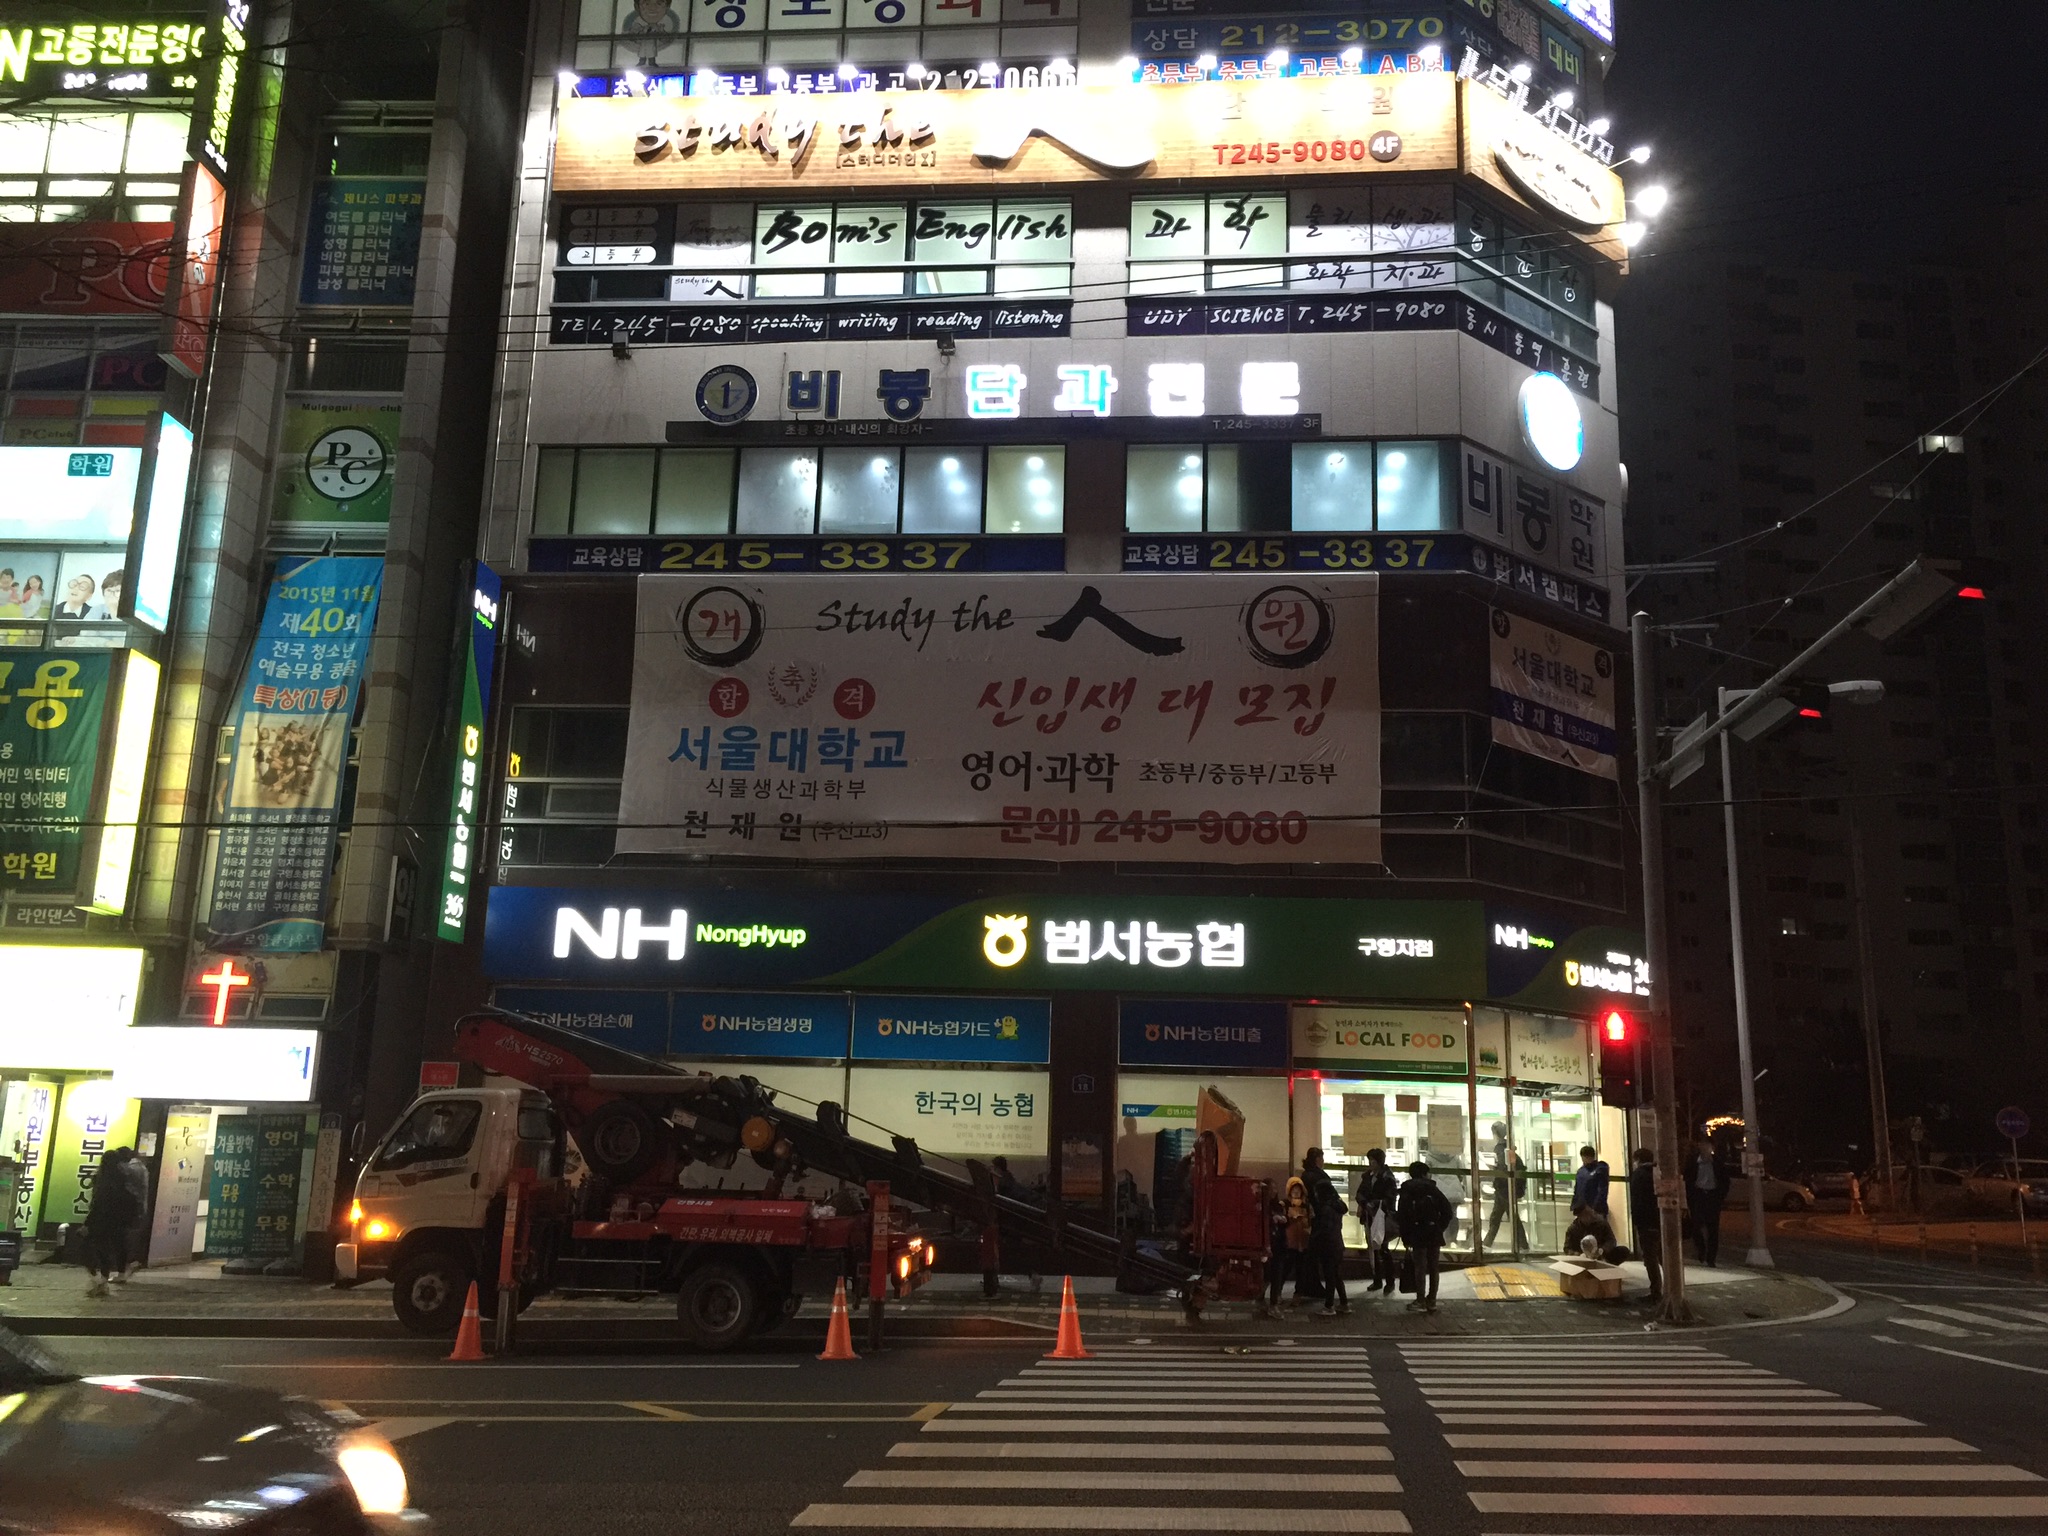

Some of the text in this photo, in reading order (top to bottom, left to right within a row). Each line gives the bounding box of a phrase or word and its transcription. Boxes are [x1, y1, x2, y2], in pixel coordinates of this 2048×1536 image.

[1144, 17, 1444, 51] 상담 212-3070
[1548, 38, 1579, 85] 대비
[1213, 136, 1399, 165] T245-9080 4F
[385, 193, 422, 205] 피부과
[763, 210, 898, 255] Bom's
[914, 209, 1068, 251] English
[320, 251, 347, 263] 비만
[838, 312, 897, 333] writing
[916, 311, 982, 331] reading
[995, 309, 1065, 331] listening
[1210, 306, 1285, 325] SCIENCE
[787, 369, 932, 421] 비봉
[1303, 417, 1319, 428] 3F
[71, 454, 111, 476] 학원
[1467, 452, 1598, 576] 비봉 학원
[572, 547, 644, 568] 교육상담
[1124, 540, 1436, 569] 교육상담 245-3337
[278, 585, 375, 603] 2015년 11월
[1493, 552, 1603, 618] 범서캠퍼스
[279, 607, 362, 638] 제40회
[697, 607, 742, 642] 개
[815, 596, 937, 653] Study
[953, 593, 1016, 633] the
[1258, 598, 1308, 651] 원
[272, 640, 356, 661] 전국 청소년
[258, 658, 324, 681] 예술무용
[1511, 645, 1598, 698] 서울대학교
[253, 684, 349, 711] 특상(1등)
[717, 665, 866, 712] 합 축 격
[976, 676, 1338, 744] 신입생 대 모집
[667, 725, 909, 773] 서울대학교
[24, 766, 71, 784] 엑티비티
[961, 750, 1338, 794] 영어·과학 초등부/중등부/고등부
[20, 791, 68, 809] 영어진행
[705, 776, 867, 802] 식물생산과학부
[1001, 804, 1309, 847] 문의) 245-9080
[3, 851, 57, 880] 학원
[16, 908, 77, 924] 라인댄스
[553, 906, 807, 961] NH NongHyup
[1044, 920, 1434, 968] 범서농협 구영지점
[1495, 924, 1529, 950] NH
[719, 1015, 813, 1034] NH농협생명
[896, 1018, 991, 1038] NH농협카드
[1163, 1023, 1262, 1043] NH농협대출
[1335, 1030, 1456, 1049] LOCAL FOOD
[914, 1090, 1034, 1118] 한국의 농협
[216, 1135, 254, 1154] 겨울방학
[265, 1130, 300, 1146] 영어
[214, 1159, 251, 1179] 예체능은
[259, 1174, 296, 1189] 수학
[221, 1183, 240, 1203] 무용
[255, 1215, 292, 1232] 무용
